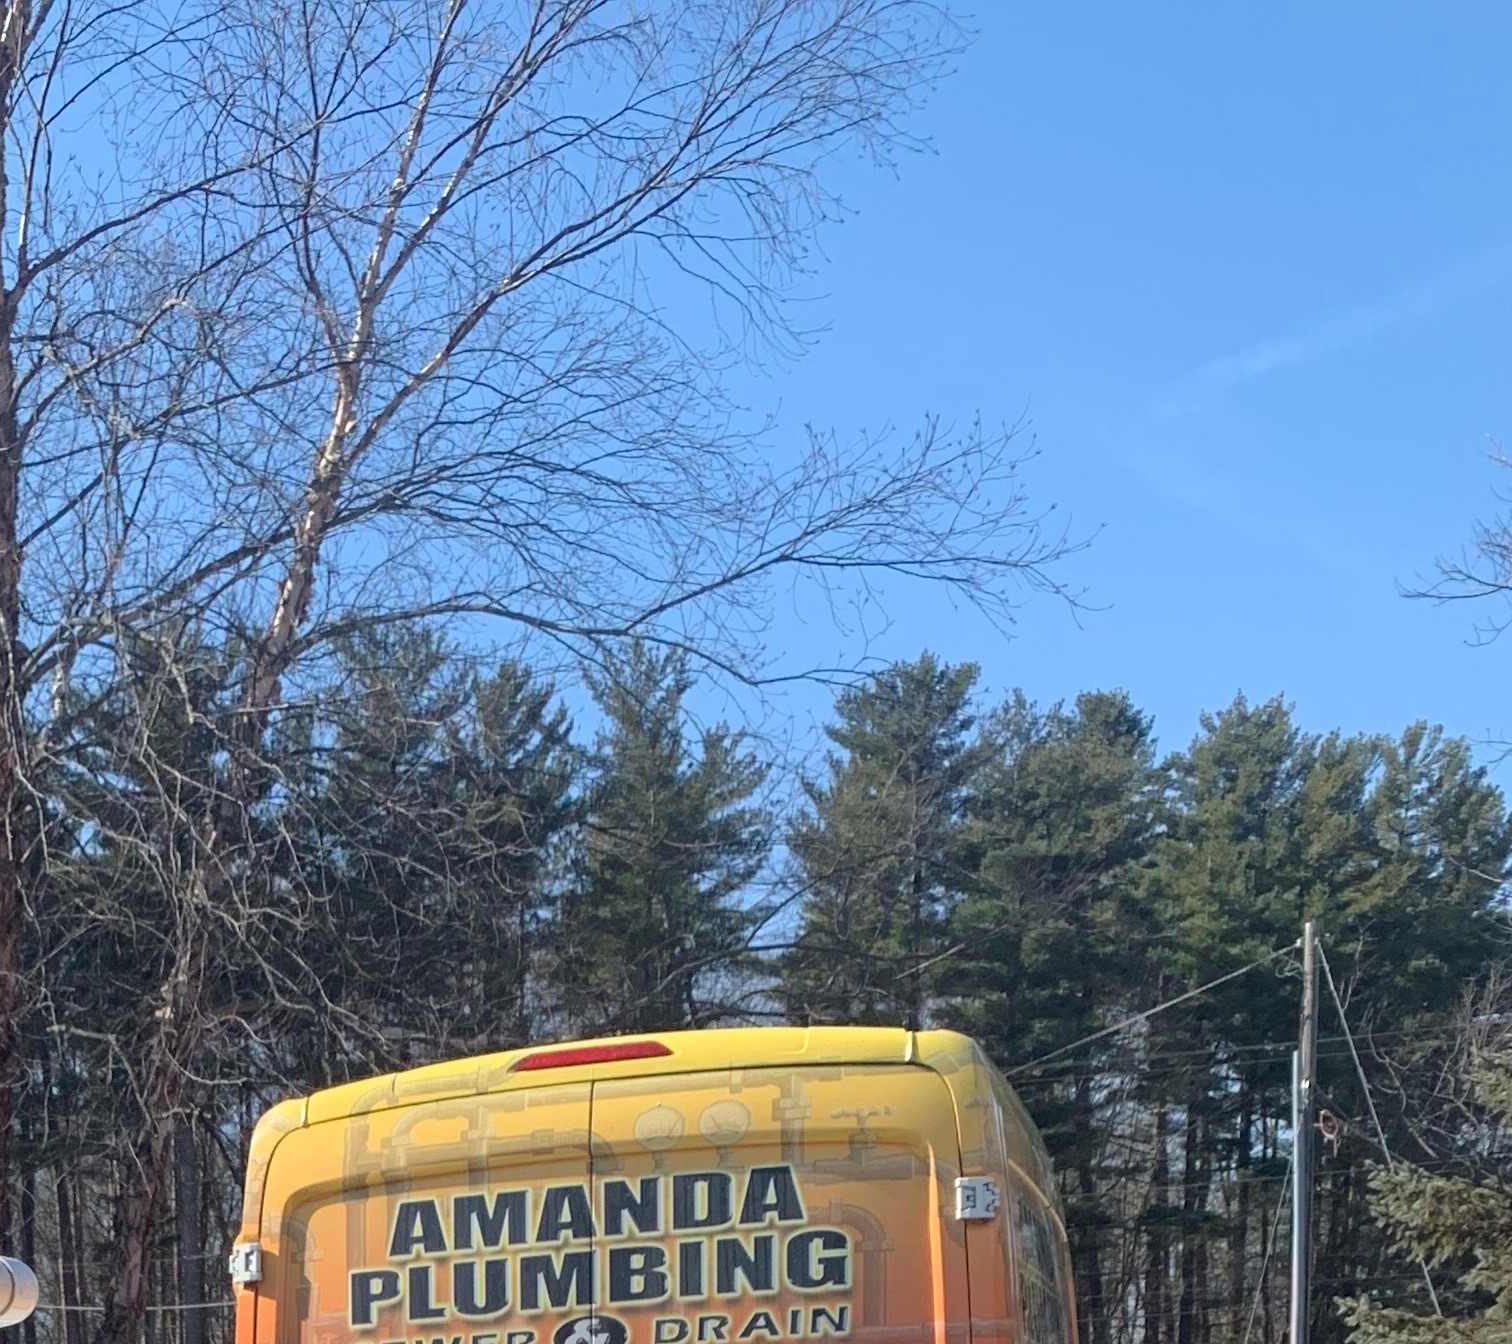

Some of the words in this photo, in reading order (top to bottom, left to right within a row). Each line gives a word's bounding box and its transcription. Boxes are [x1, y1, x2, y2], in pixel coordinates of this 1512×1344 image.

[388, 1164, 805, 1257] AMANDA
[350, 1229, 849, 1326] PLUMBING
[653, 1304, 849, 1344] DRAIN
